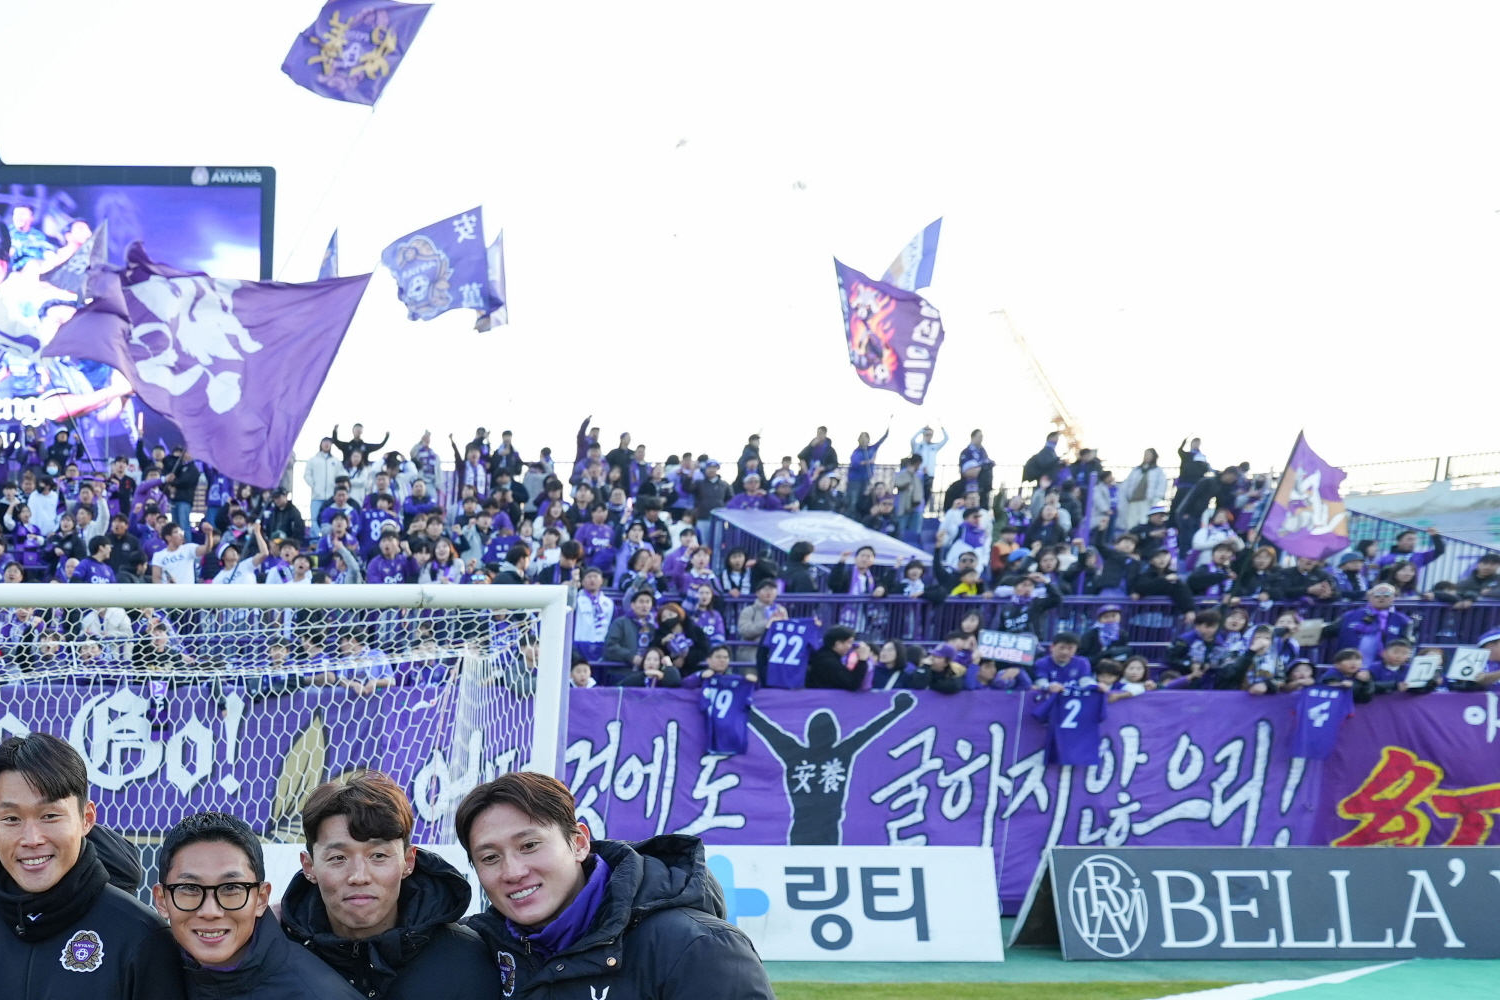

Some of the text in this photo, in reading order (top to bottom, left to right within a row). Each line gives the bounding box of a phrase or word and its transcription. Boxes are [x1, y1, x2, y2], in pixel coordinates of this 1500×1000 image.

[211, 171, 262, 183] ANYANG
[769, 632, 803, 666] 22
[1060, 699, 1082, 729] 2
[69, 686, 245, 798] Go!
[792, 759, 847, 794] 安養
[784, 866, 930, 951] 링티
[1152, 857, 1500, 950] BELLA'
[73, 942, 95, 950] ANYANG
